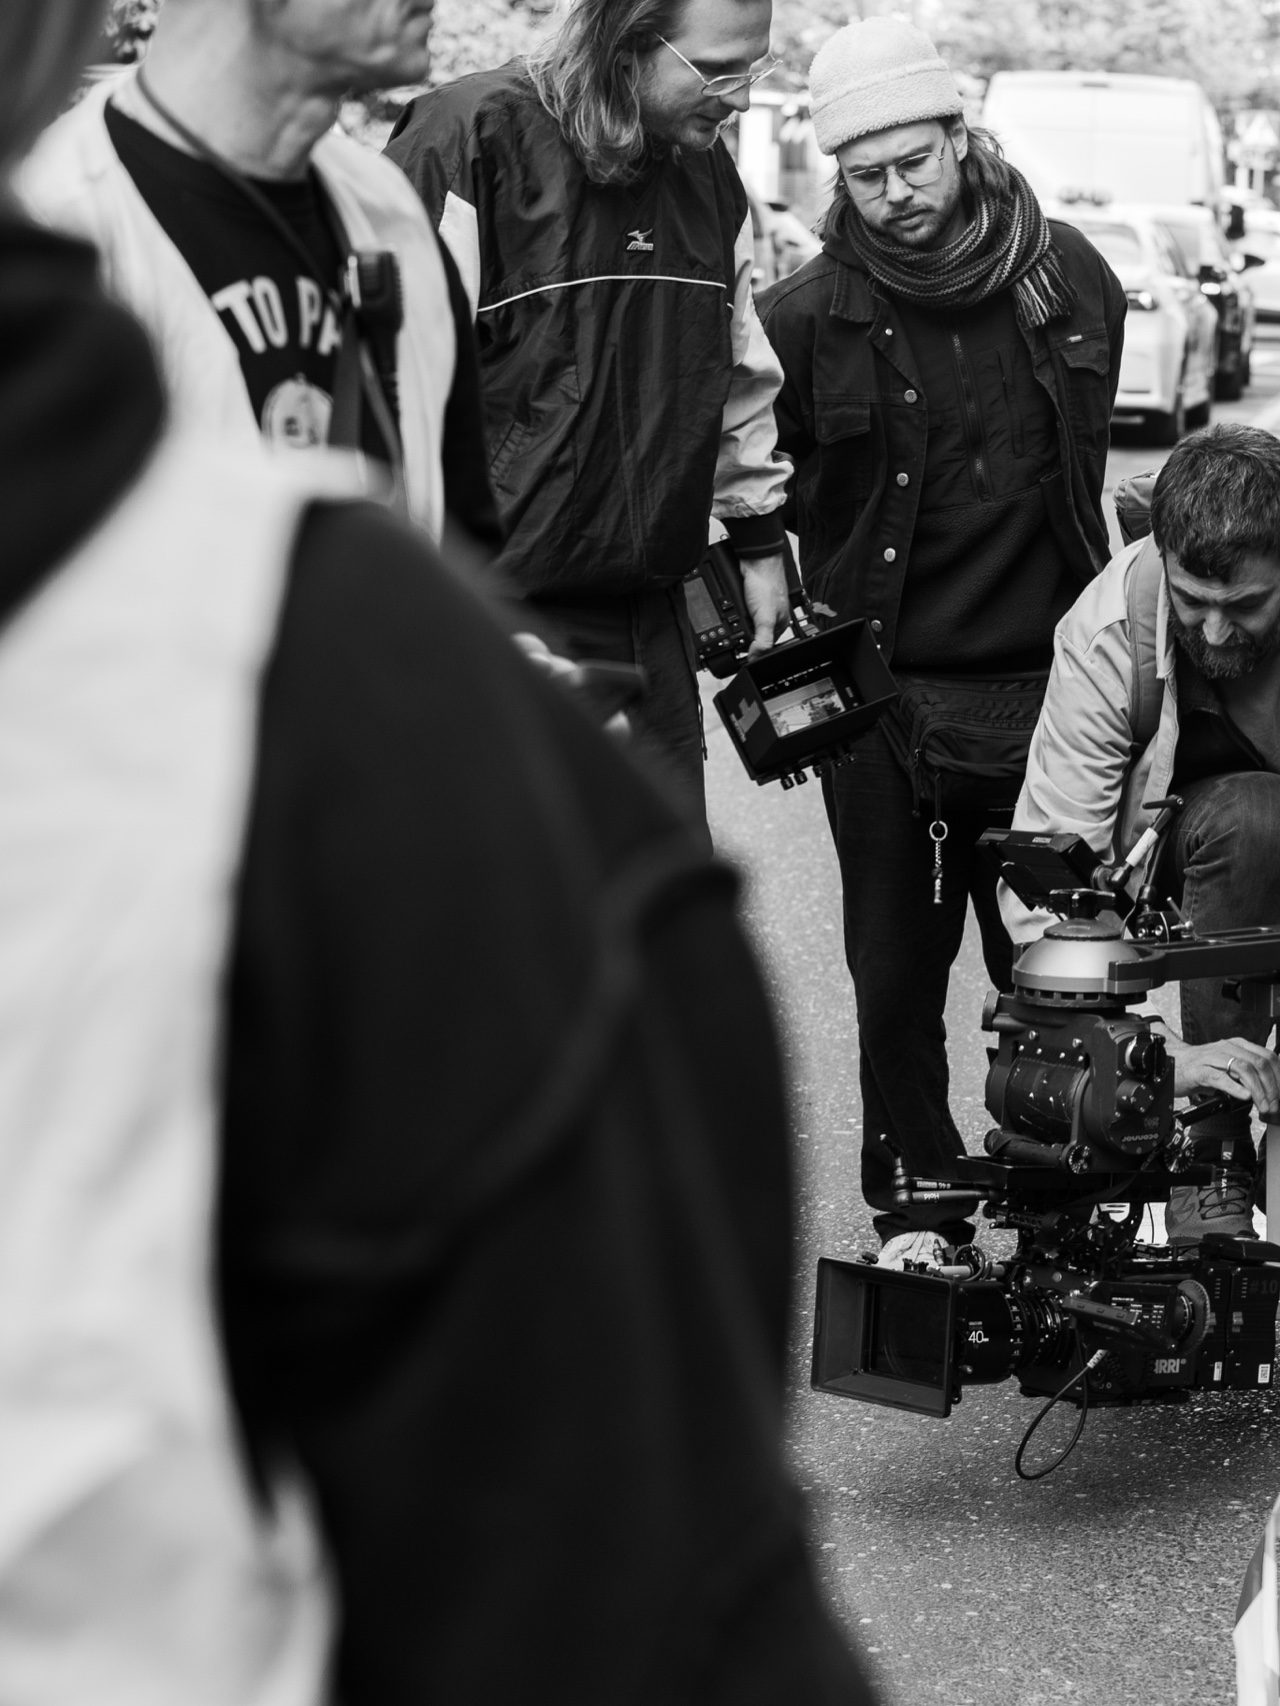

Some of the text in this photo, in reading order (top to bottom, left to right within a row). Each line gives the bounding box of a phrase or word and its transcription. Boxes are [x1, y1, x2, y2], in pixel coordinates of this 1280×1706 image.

[211, 276, 288, 354] TO
[1121, 1133, 1159, 1143] oconnor
[923, 1192, 940, 1201] Hold
[1249, 1279, 1278, 1294] #10
